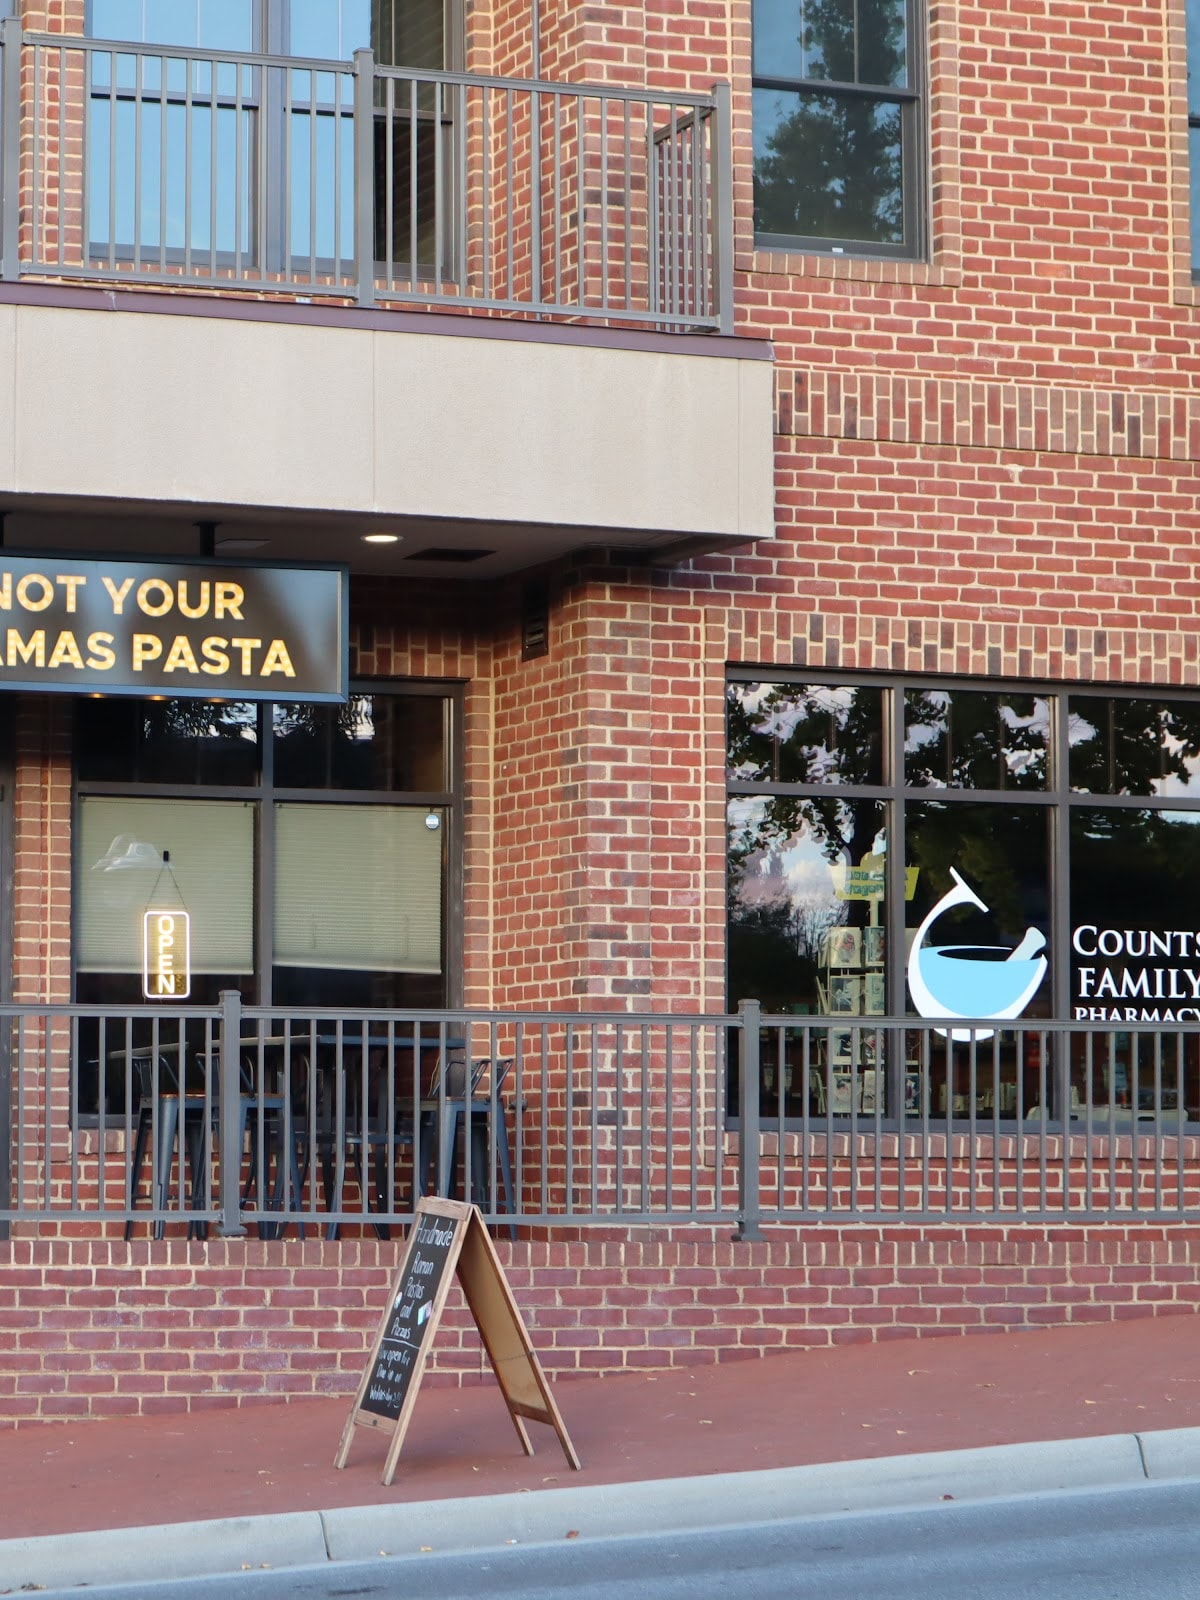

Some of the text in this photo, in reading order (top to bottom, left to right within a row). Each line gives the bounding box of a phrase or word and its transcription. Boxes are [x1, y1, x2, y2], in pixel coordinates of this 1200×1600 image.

[101, 576, 245, 620] YOUR
[132, 634, 296, 678] PASTA
[158, 915, 176, 994] OPEN
[1078, 967, 1200, 999] FAMILY
[417, 1215, 454, 1247] Handmade
[411, 1251, 435, 1275] Roman
[391, 1317, 412, 1339] Pizzas
